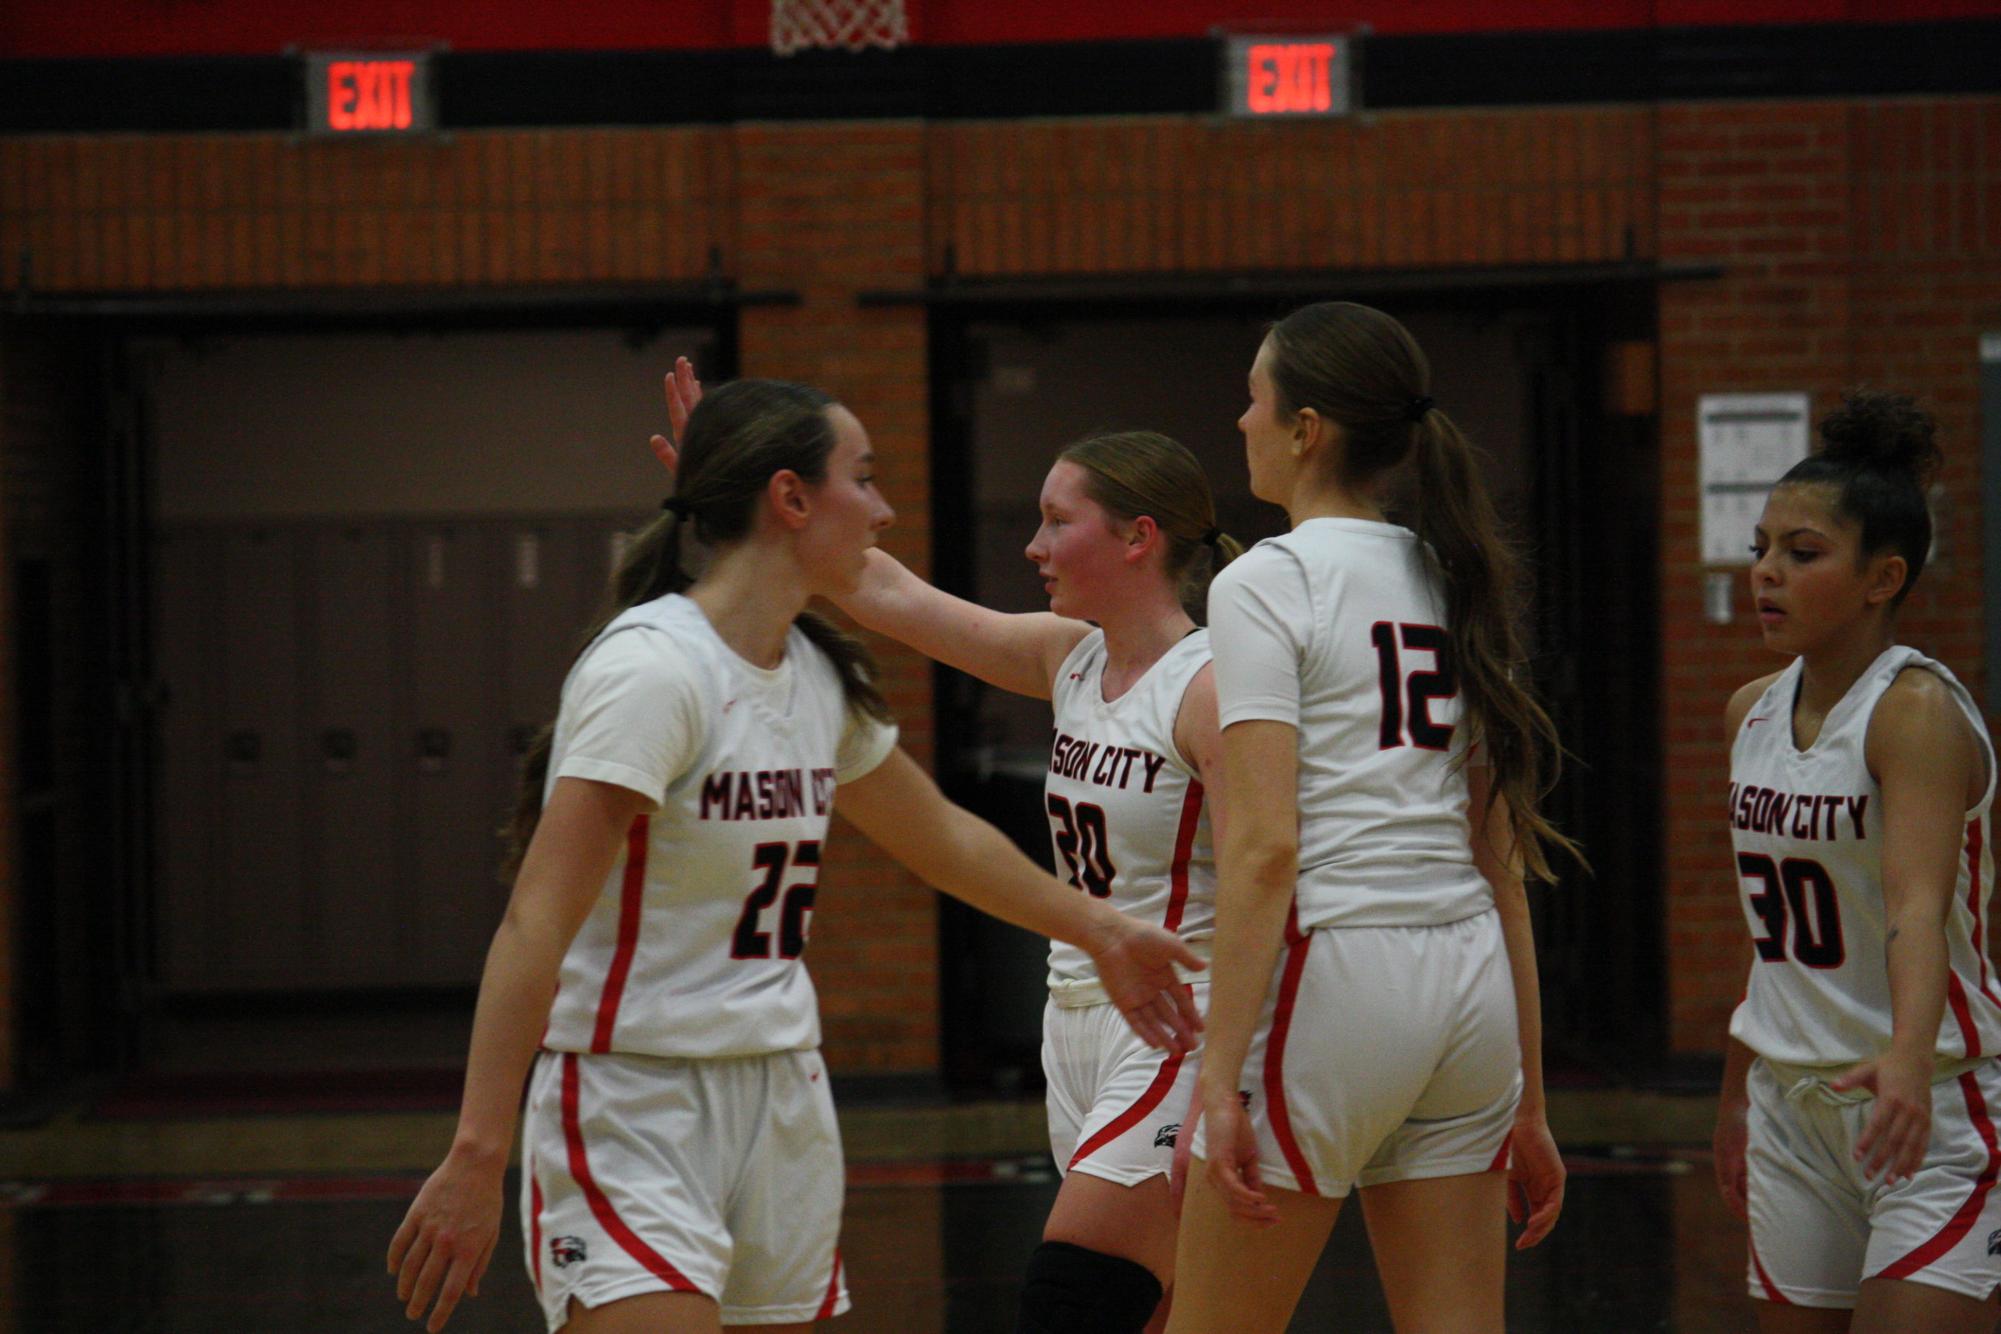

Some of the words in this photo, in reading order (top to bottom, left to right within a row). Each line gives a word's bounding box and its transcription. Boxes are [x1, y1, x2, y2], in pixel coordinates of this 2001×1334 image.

[328, 61, 415, 129] EXIT
[1248, 44, 1336, 112] EXIT
[1371, 621, 1457, 751] 12
[700, 769, 804, 820] MASON
[1050, 728, 1099, 782] SON
[1093, 744, 1166, 793] CITY
[1792, 795, 1868, 840] CITY
[729, 840, 821, 959] 22
[1738, 852, 1845, 969] 30
